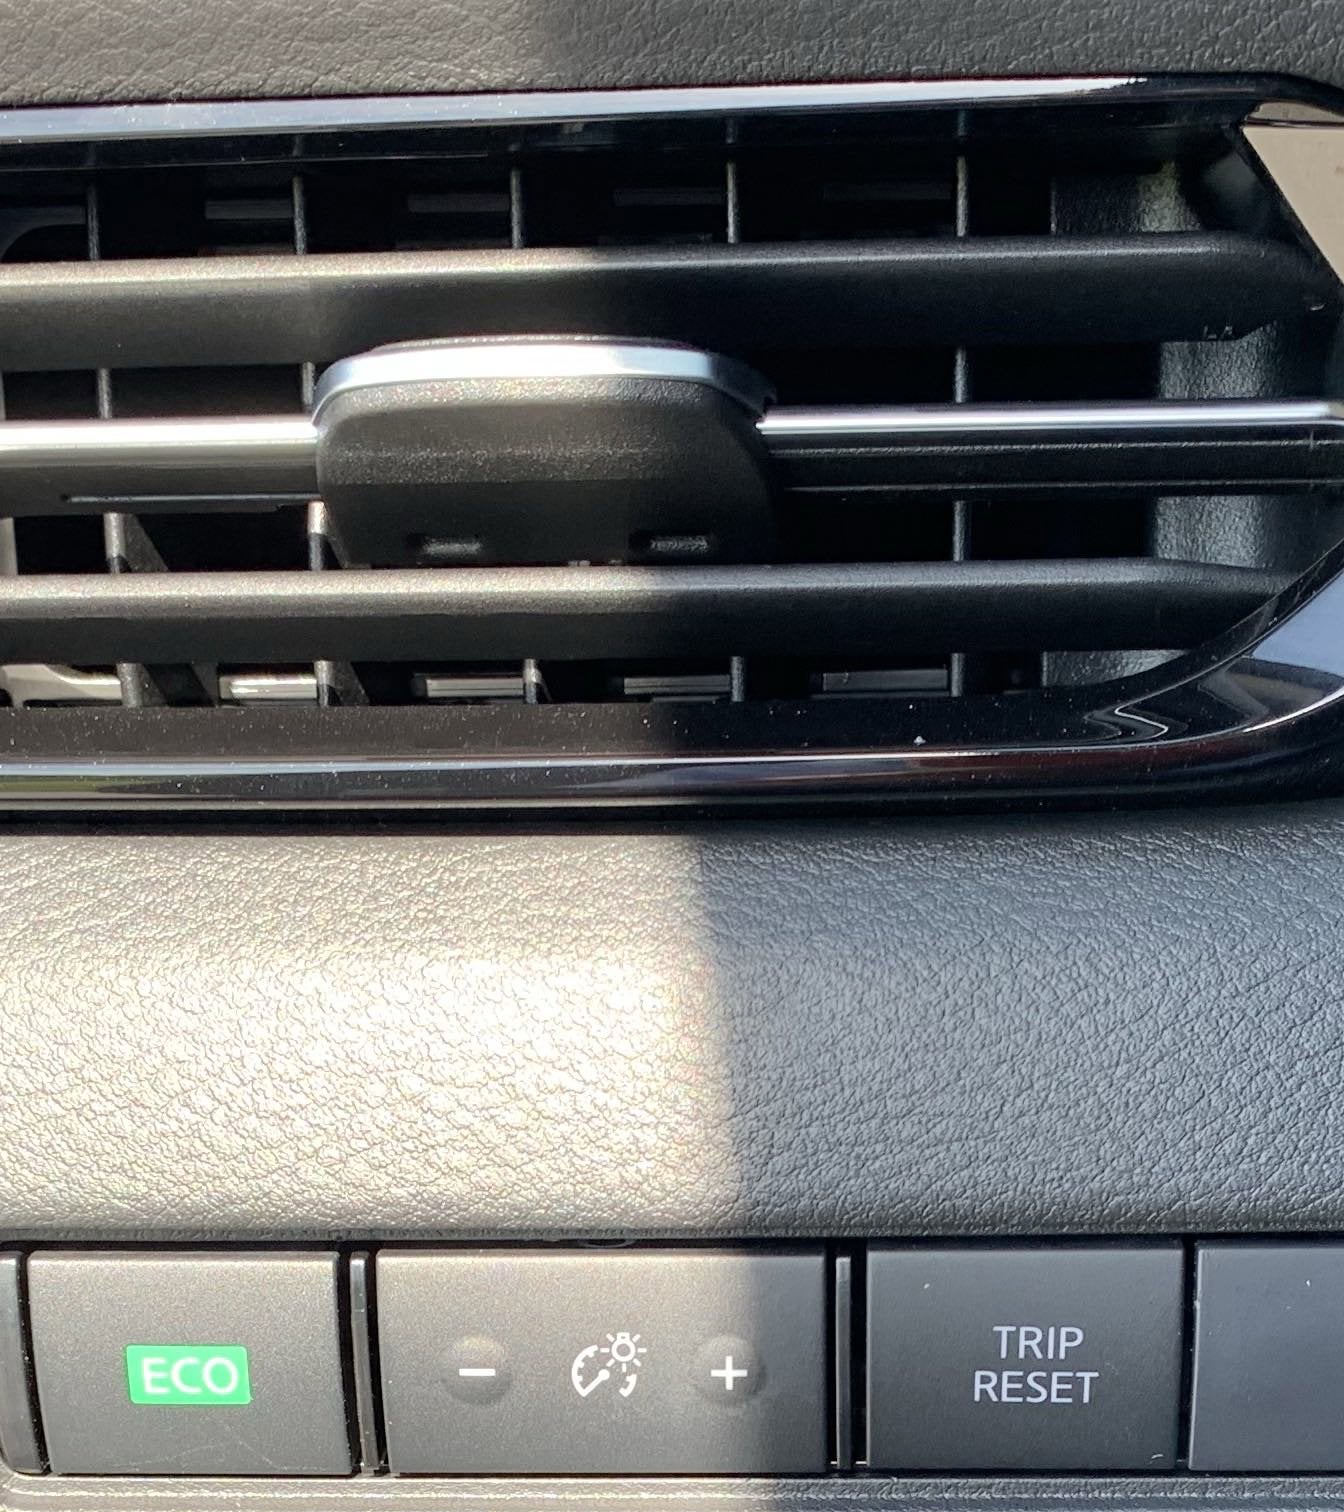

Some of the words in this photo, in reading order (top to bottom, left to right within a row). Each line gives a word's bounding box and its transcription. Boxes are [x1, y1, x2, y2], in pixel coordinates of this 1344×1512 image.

[992, 1325, 1084, 1360] TRIP
[141, 1355, 240, 1395] ECO
[973, 1370, 1099, 1404] RESET
